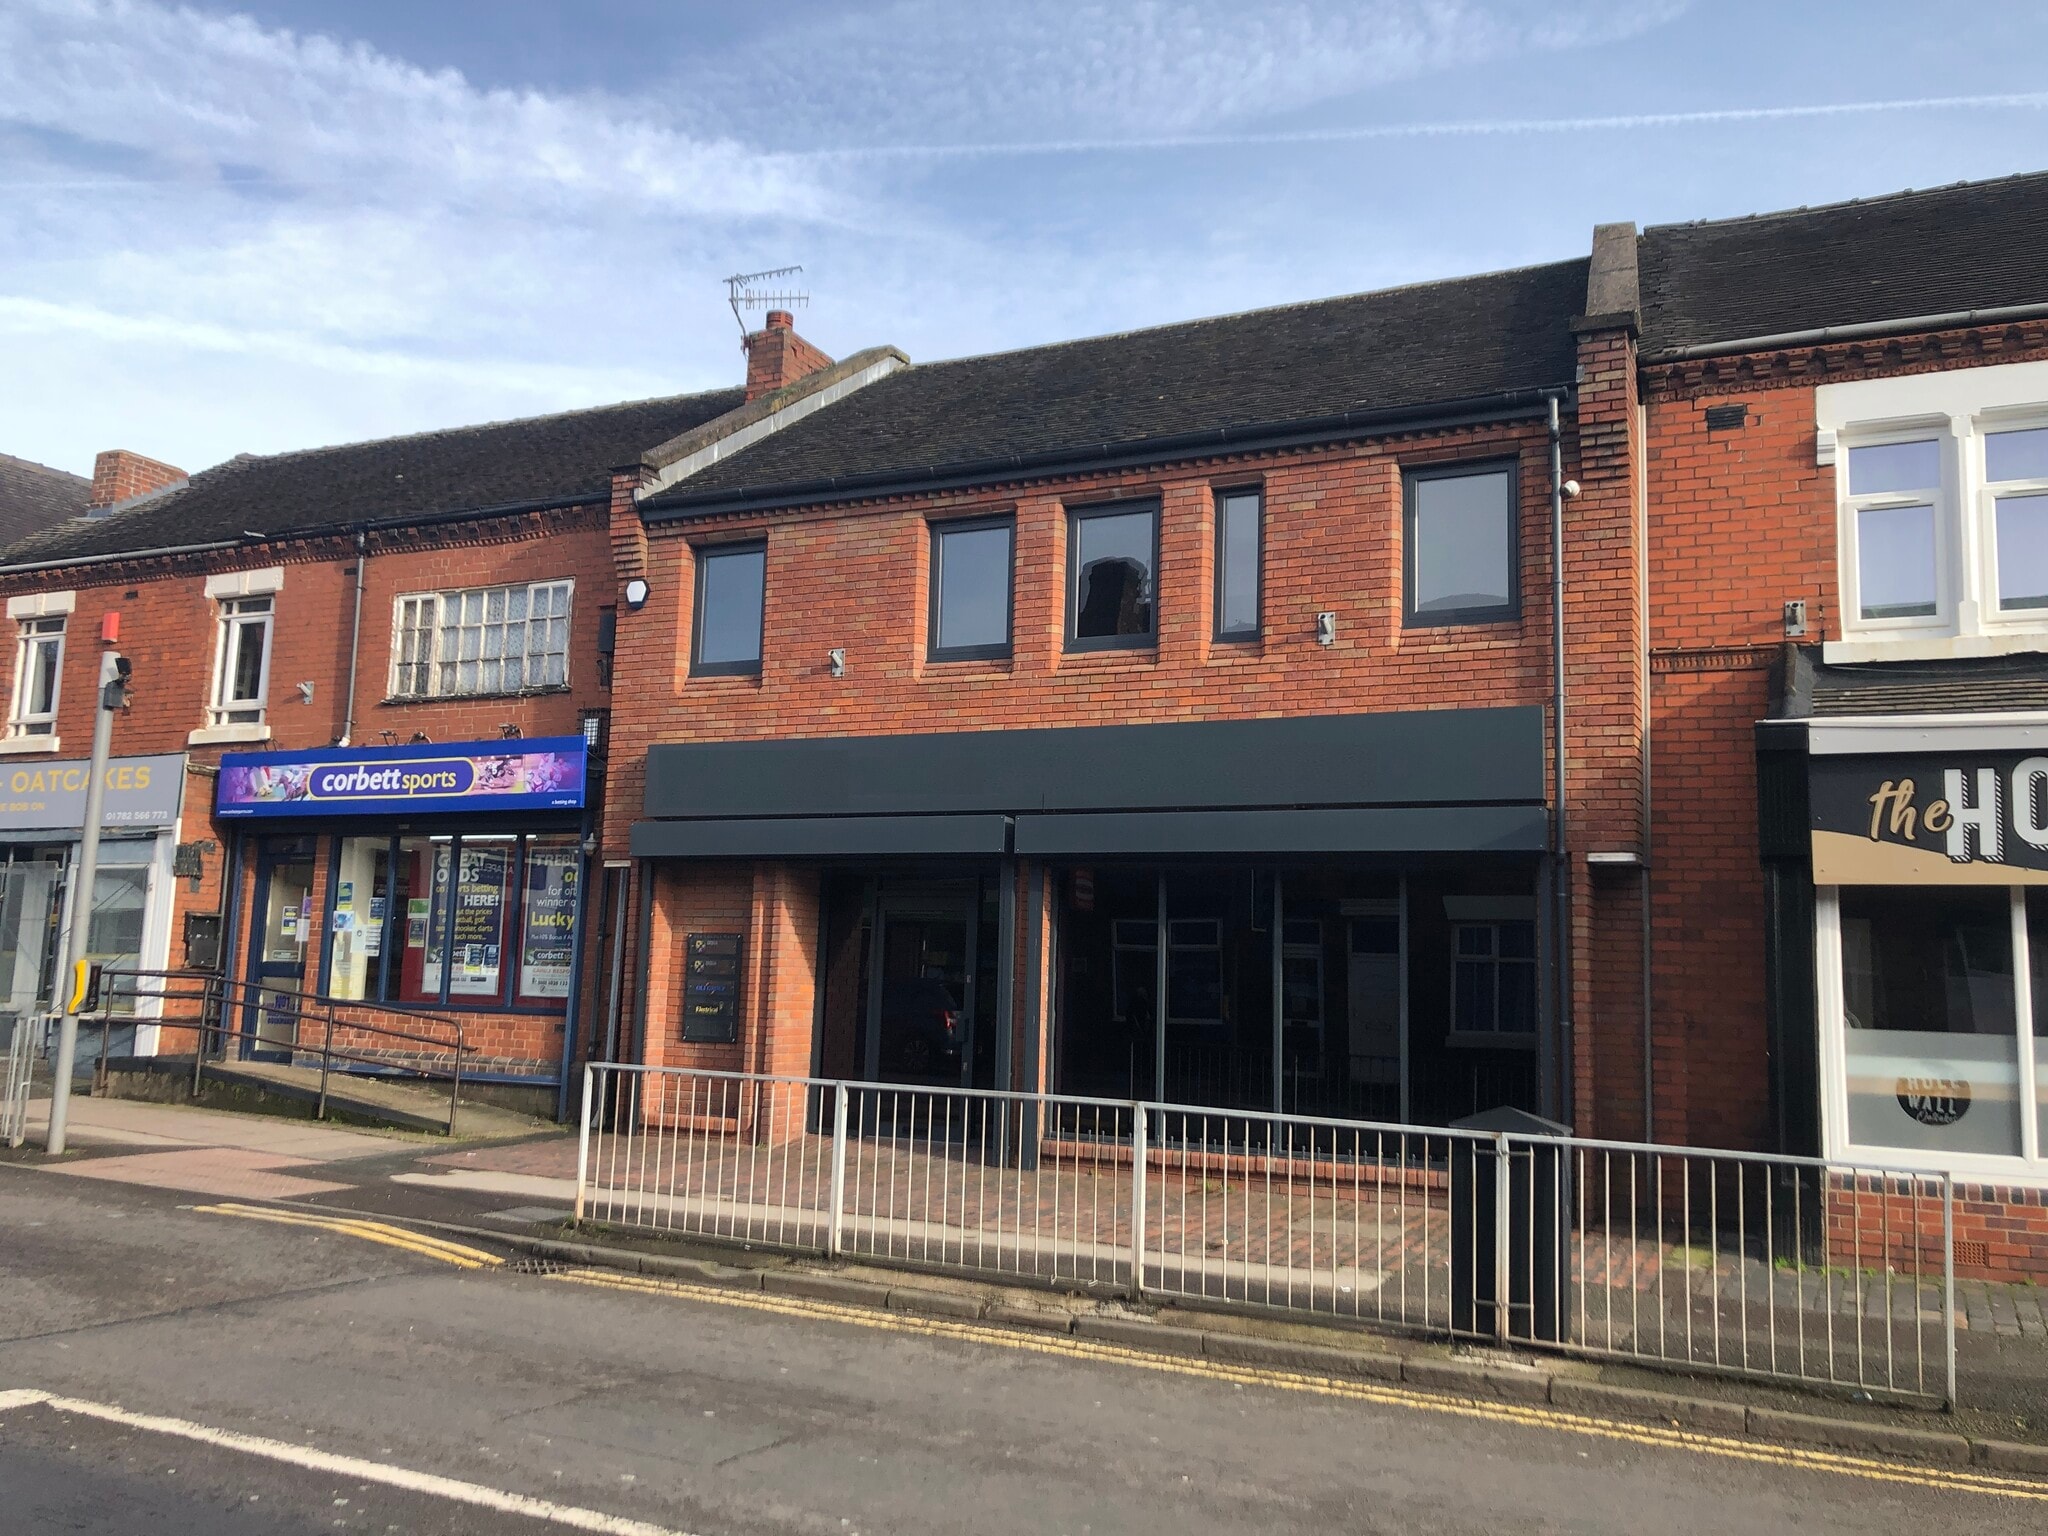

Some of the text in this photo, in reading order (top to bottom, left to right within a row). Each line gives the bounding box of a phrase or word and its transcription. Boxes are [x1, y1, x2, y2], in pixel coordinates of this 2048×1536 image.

[322, 765, 456, 795] corbett sports
[32, 802, 45, 810] ON
[1868, 778, 1954, 841] the
[106, 812, 132, 820] 01782
[152, 811, 168, 819] 773
[437, 852, 488, 868] GEAT
[535, 853, 579, 867] TREBL
[436, 868, 480, 883] ODS
[471, 884, 499, 895] betting
[548, 885, 562, 896] for
[464, 894, 500, 907] HERE!
[536, 896, 569, 907] winner
[531, 911, 575, 930] Lucky
[537, 950, 564, 960] corbett
[1907, 1094, 1957, 1115] WALL
